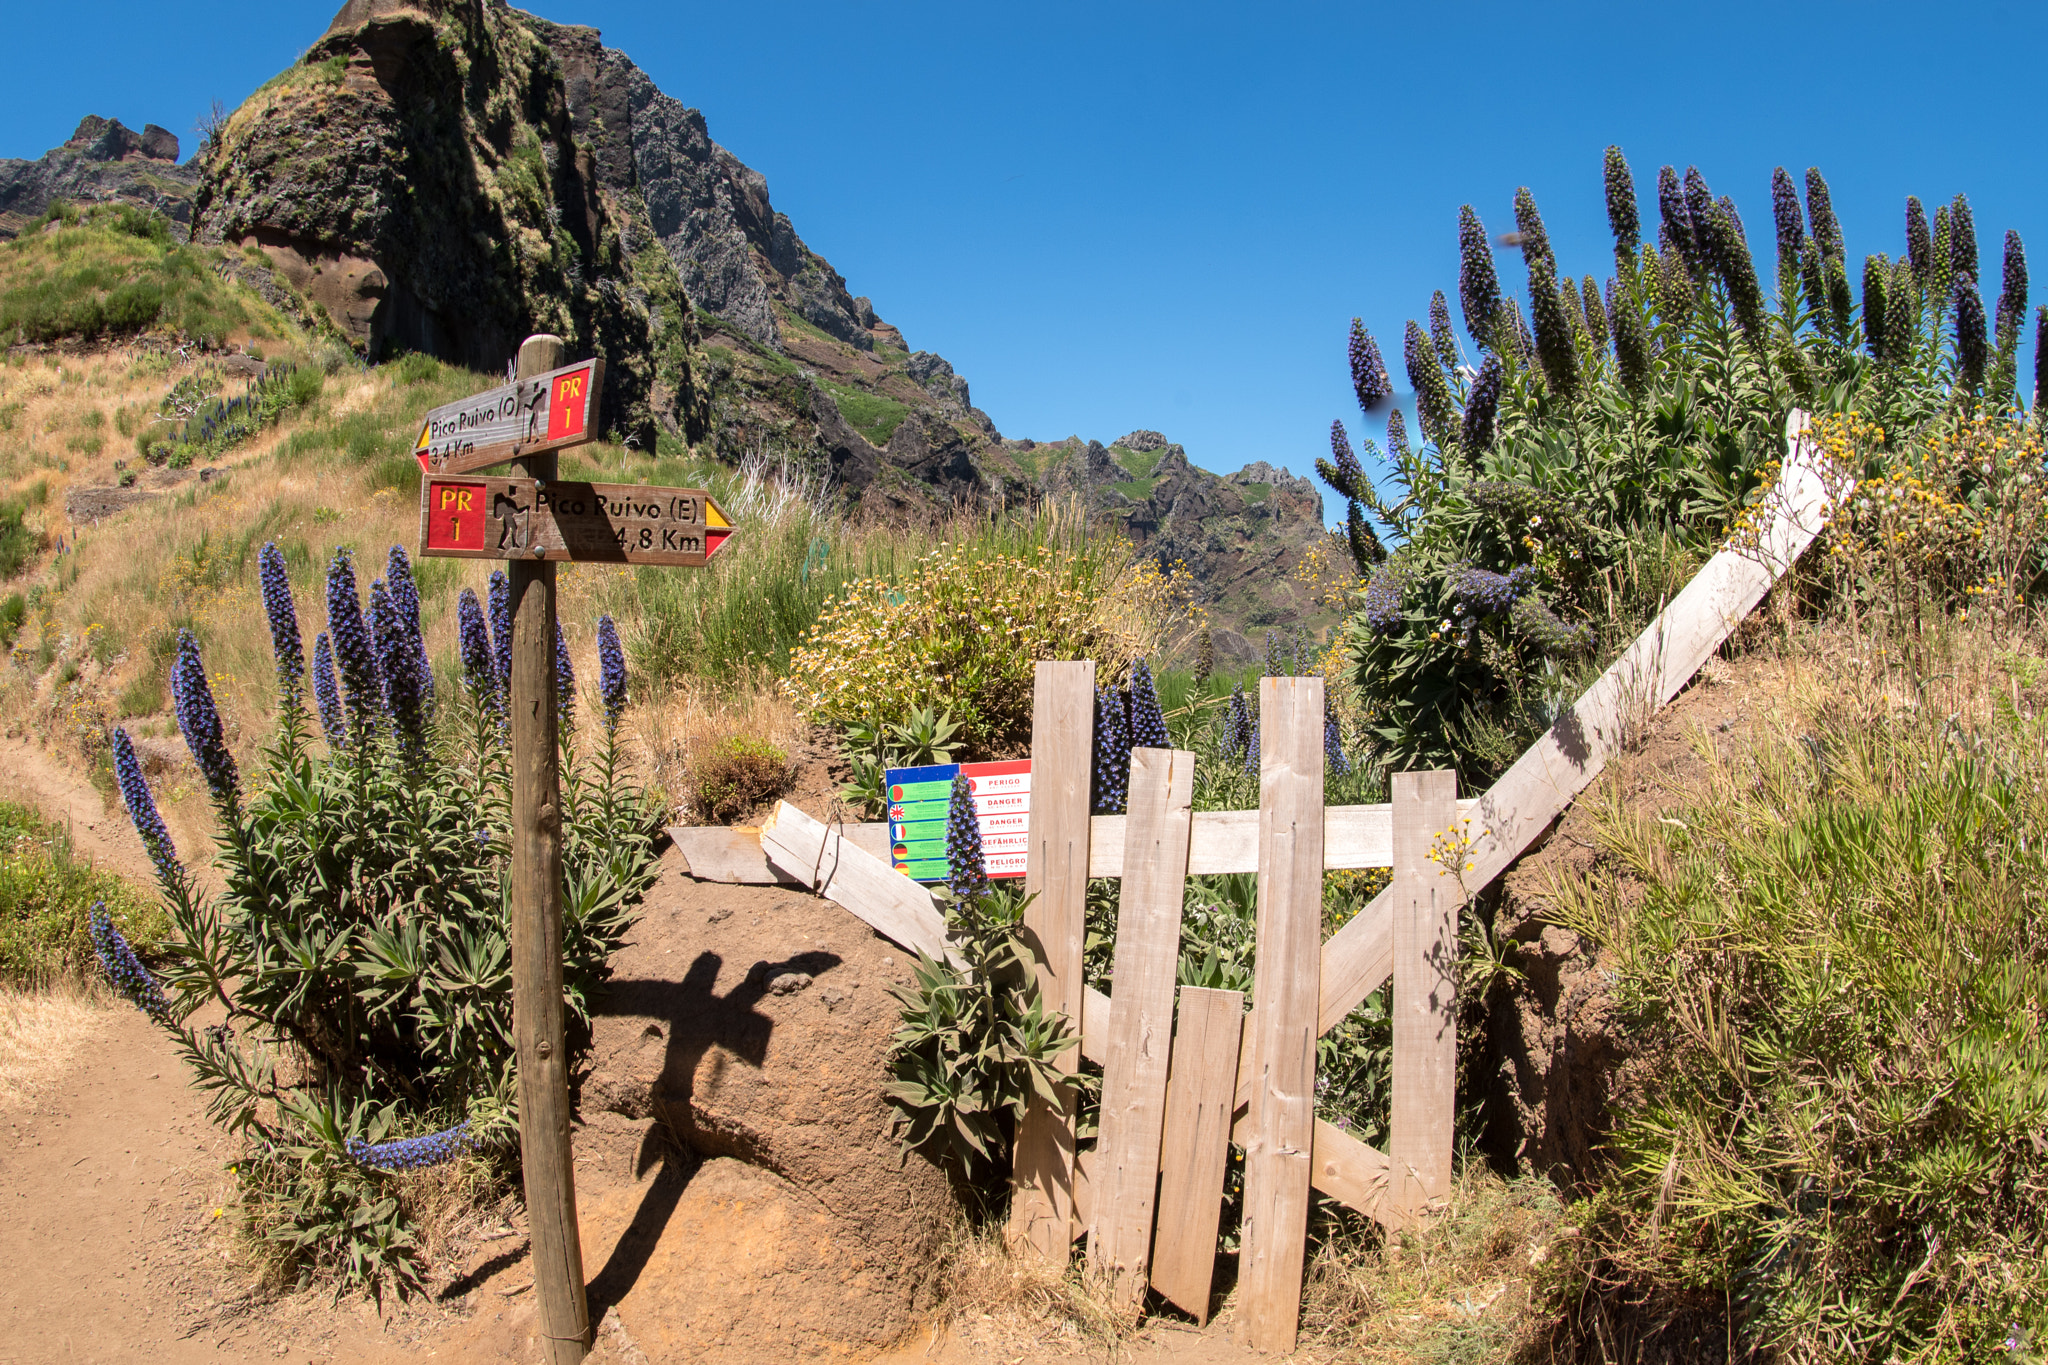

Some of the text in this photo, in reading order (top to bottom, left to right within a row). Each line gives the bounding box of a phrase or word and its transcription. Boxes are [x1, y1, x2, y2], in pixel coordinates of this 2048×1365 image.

[559, 375, 582, 402] PR
[431, 397, 519, 440] Pico Ruivo (O)
[565, 405, 571, 429] 1
[431, 439, 474, 467] 3,4 Km
[440, 487, 472, 511] PR
[535, 491, 698, 524] Pico Ruivo (E)
[450, 517, 459, 541] 1
[613, 527, 700, 553] 4,8 Km
[988, 778, 1020, 786] PERIGO
[987, 798, 1023, 806] DANGER
[989, 818, 1023, 826] DANGER
[981, 837, 1028, 846] GEFÄHRLIC
[990, 858, 1026, 866] PELIGRO
